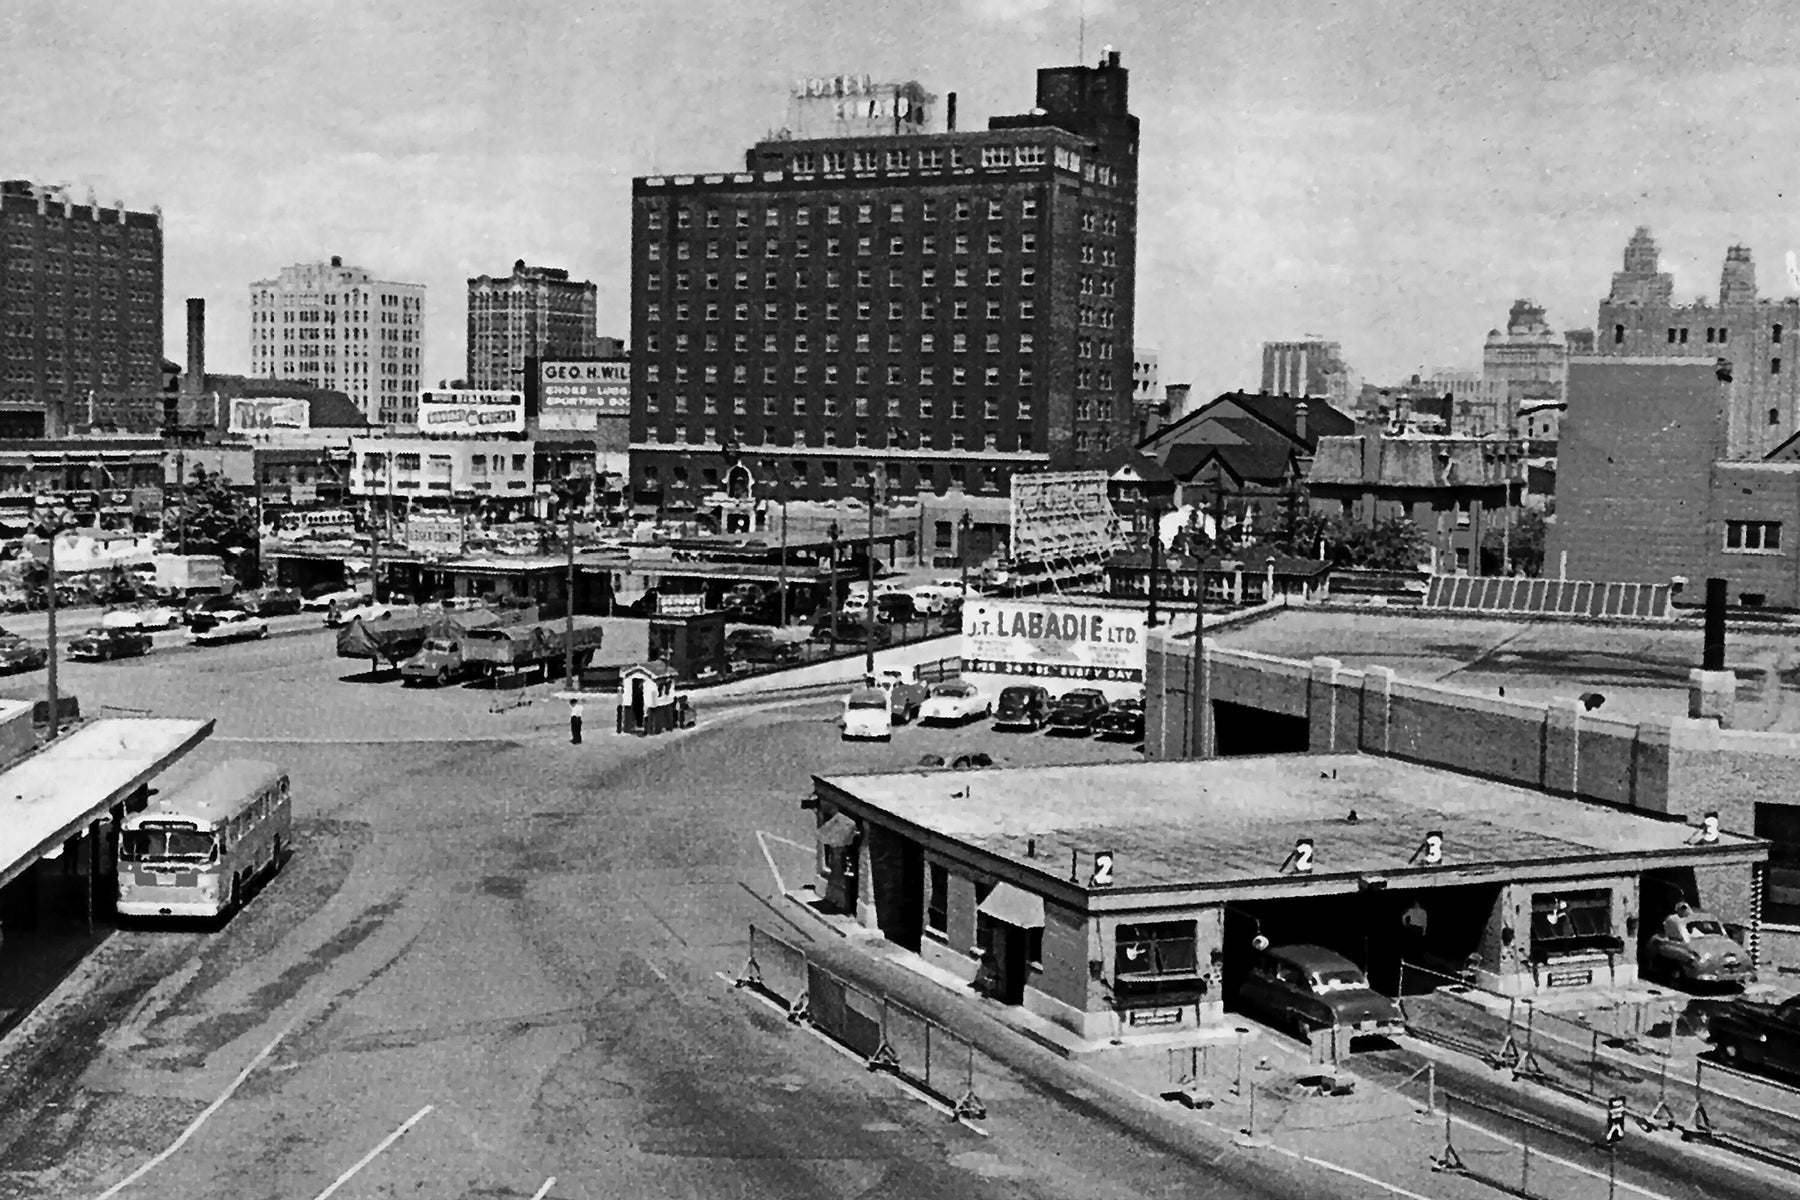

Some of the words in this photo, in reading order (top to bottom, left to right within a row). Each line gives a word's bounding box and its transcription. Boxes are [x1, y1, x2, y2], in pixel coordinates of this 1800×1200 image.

[545, 365, 583, 379] GEO.
[967, 621, 994, 637] J.T.
[997, 610, 1103, 643] LABADIE
[1107, 669, 1134, 681] DAY
[1704, 817, 1719, 842] 3
[1297, 843, 1313, 872] 2
[1427, 835, 1442, 863] 3
[1096, 855, 1113, 884] 2
